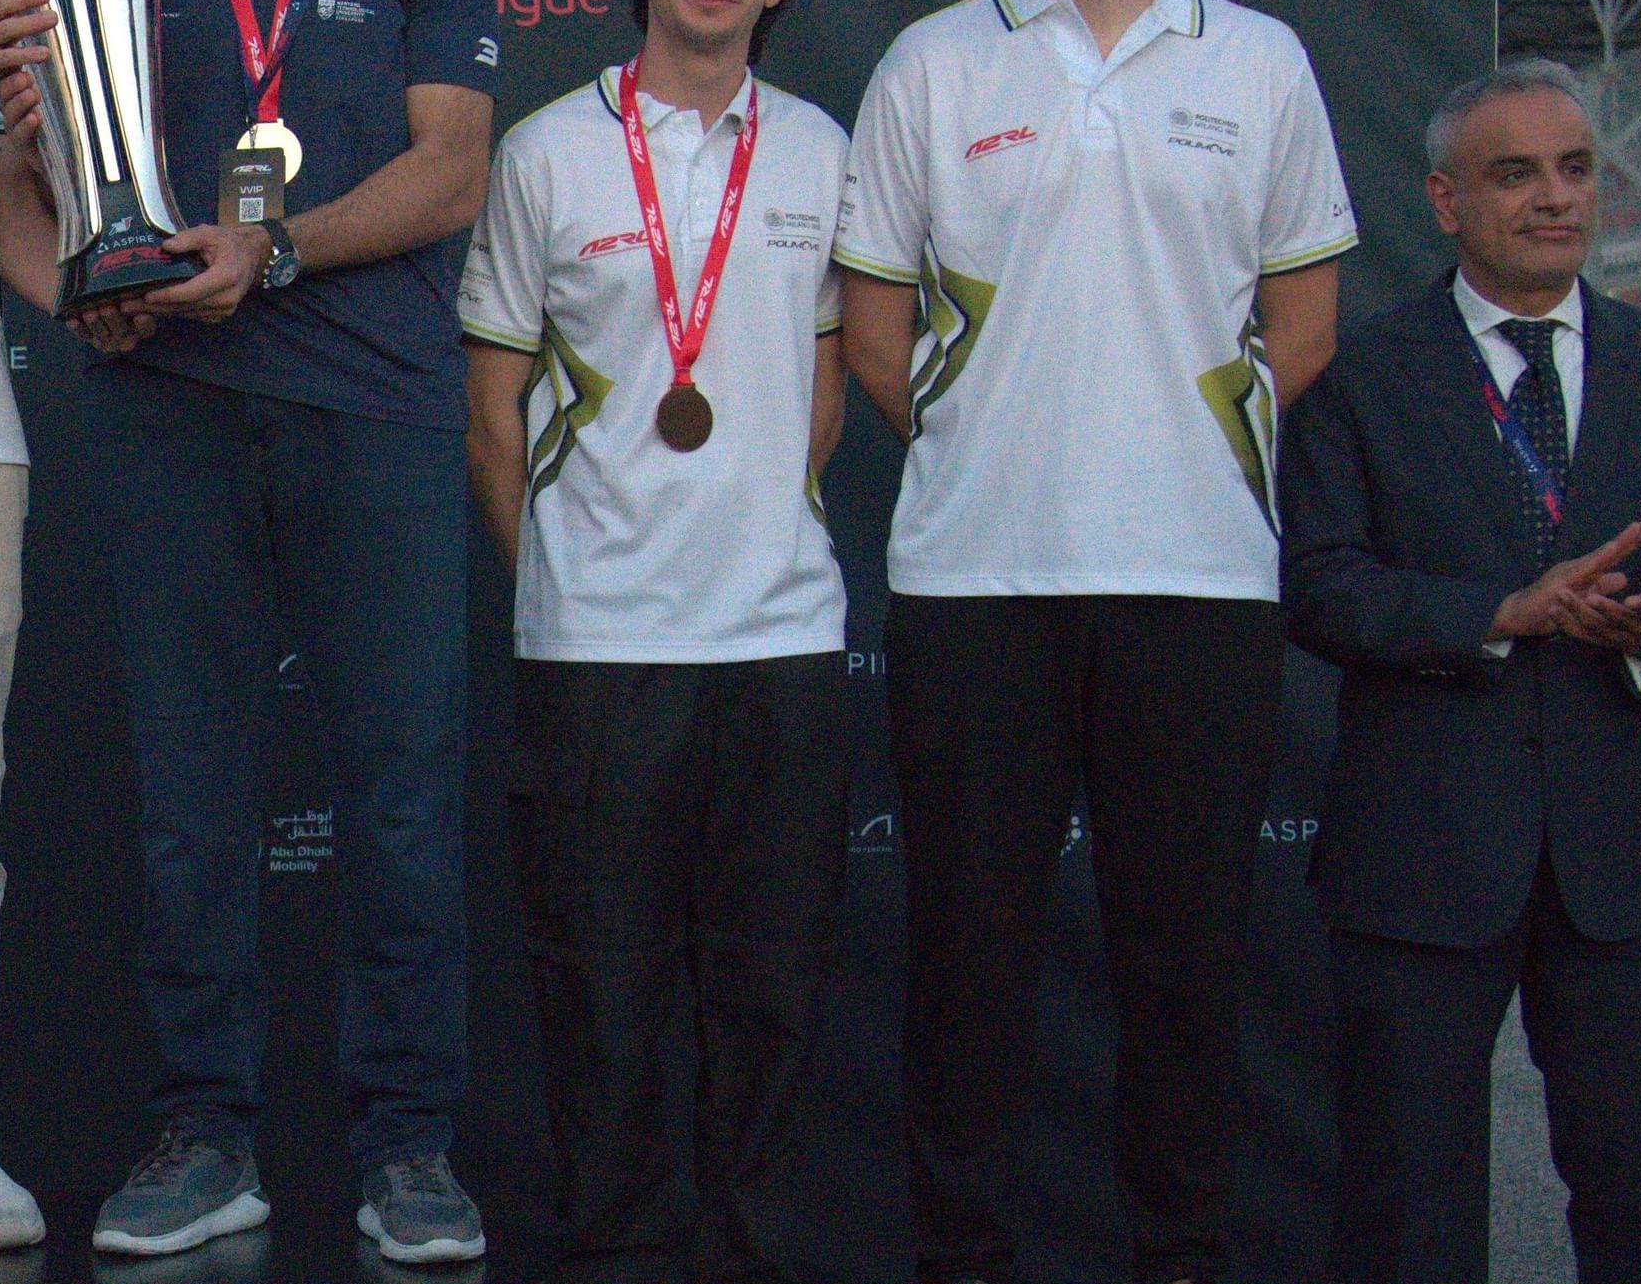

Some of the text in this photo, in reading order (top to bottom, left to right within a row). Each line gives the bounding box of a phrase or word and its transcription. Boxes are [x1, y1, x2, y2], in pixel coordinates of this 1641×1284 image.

[627, 110, 646, 164] A2RL
[964, 125, 1037, 160] A2RL
[719, 186, 739, 238] A2RL
[112, 235, 155, 249] ASPIRE
[646, 203, 666, 257] A2RL
[695, 276, 715, 329] A2RL
[1259, 819, 1319, 842] ASP
[269, 860, 318, 873] Mobility
[270, 845, 333, 857] Abu Dhabi
